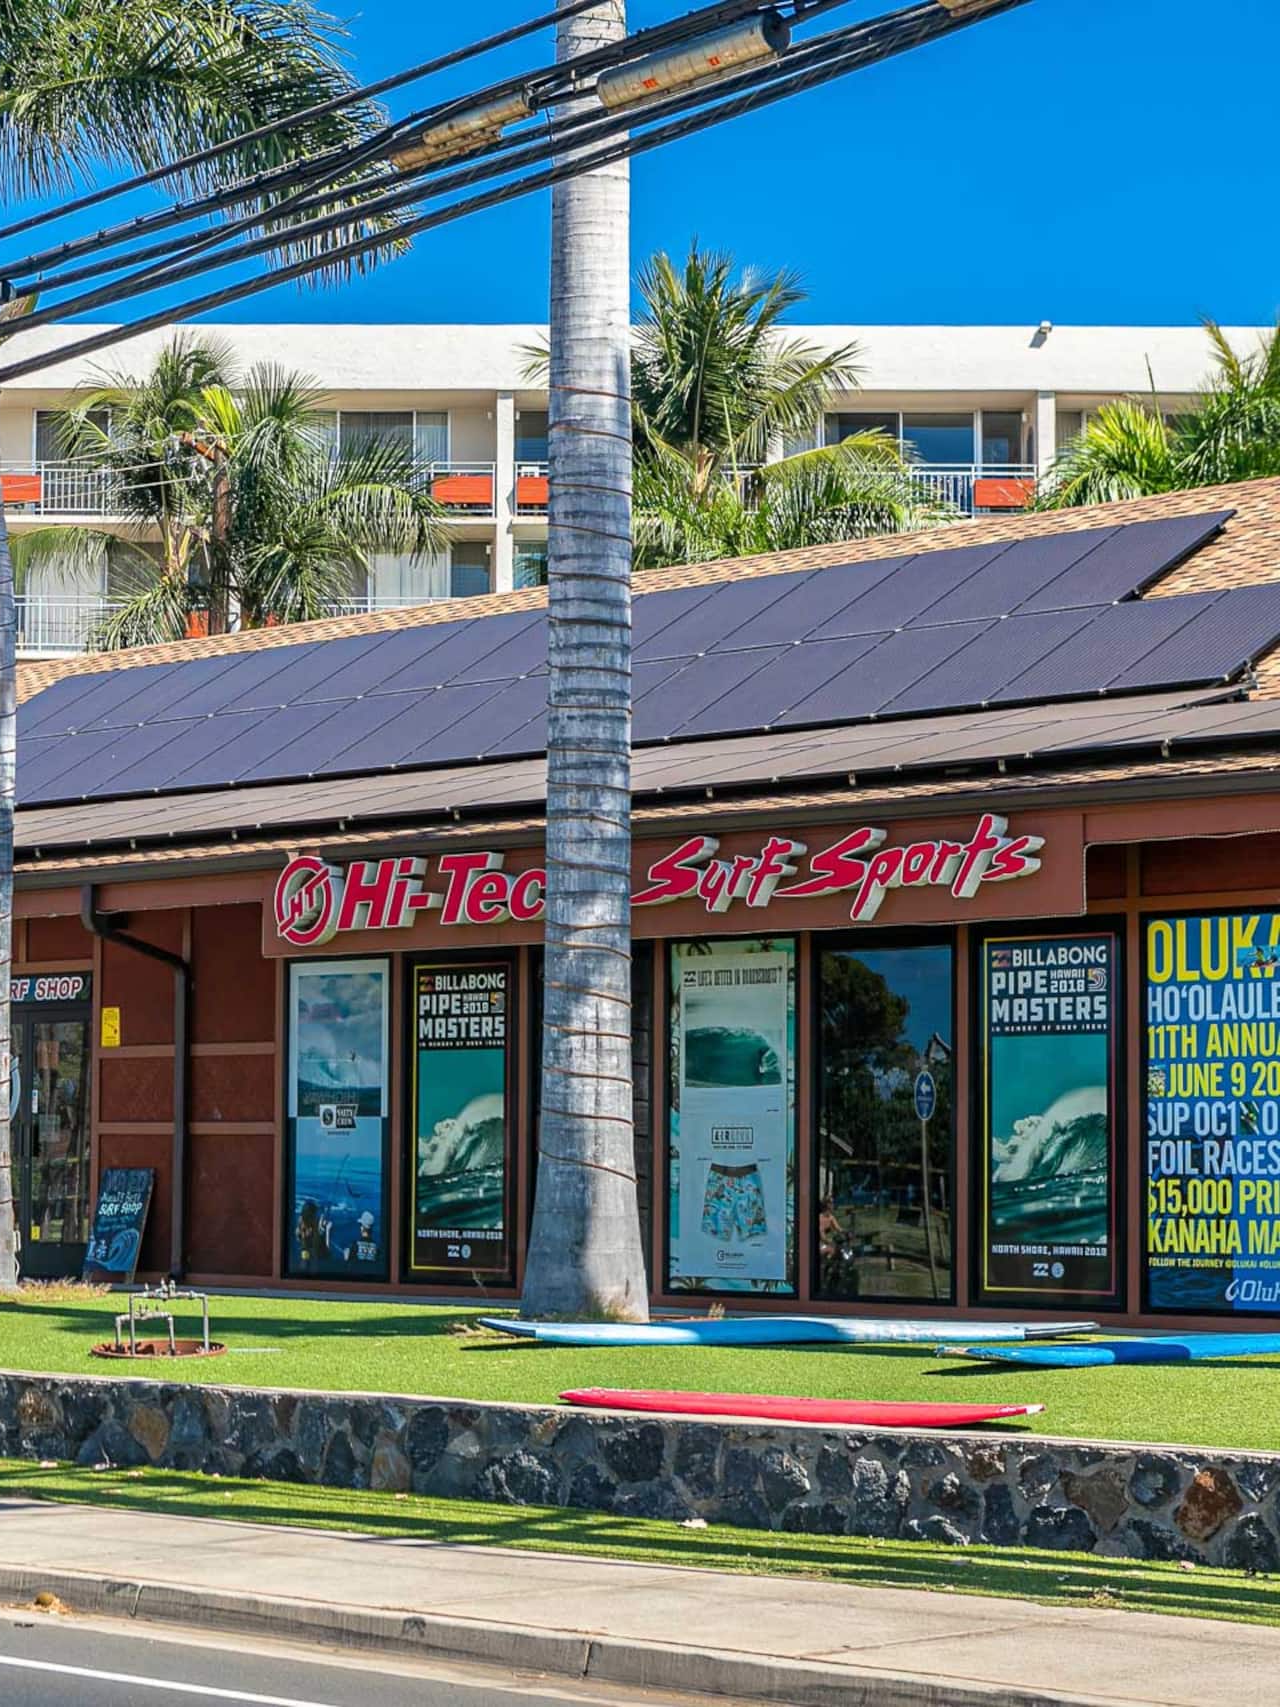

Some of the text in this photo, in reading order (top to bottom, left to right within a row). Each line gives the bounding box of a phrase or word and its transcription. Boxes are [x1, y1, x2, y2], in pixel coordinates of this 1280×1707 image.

[336, 813, 1044, 931] Hi-Tec Surf Sports
[1012, 945, 1107, 967] BILLABONG
[10, 976, 83, 1002] RF SHOP
[435, 973, 505, 991] BILLABONG
[991, 968, 1085, 995] PIPE HAWAII
[1050, 980, 1085, 993] 2018
[419, 993, 461, 1015] PIPE
[463, 1002, 489, 1014] 2018
[991, 995, 1107, 1023] MASTERS
[419, 1016, 505, 1039] MASTERS
[1148, 1024, 1198, 1059] 11TH
[1168, 1061, 1280, 1098] JUNE 9 20
[1148, 1101, 1190, 1137] SUP
[1148, 1140, 1280, 1176] FOIL RACES
[1148, 1176, 1233, 1217] $15,000
[1148, 1218, 1242, 1254] KANAHA
[991, 1244, 1019, 1254] NORTH
[1084, 1247, 1107, 1256] 2018
[1148, 1257, 1175, 1267] FOLLOW
[1177, 1258, 1191, 1268] THE
[1192, 1258, 1224, 1268] JOURNEY
